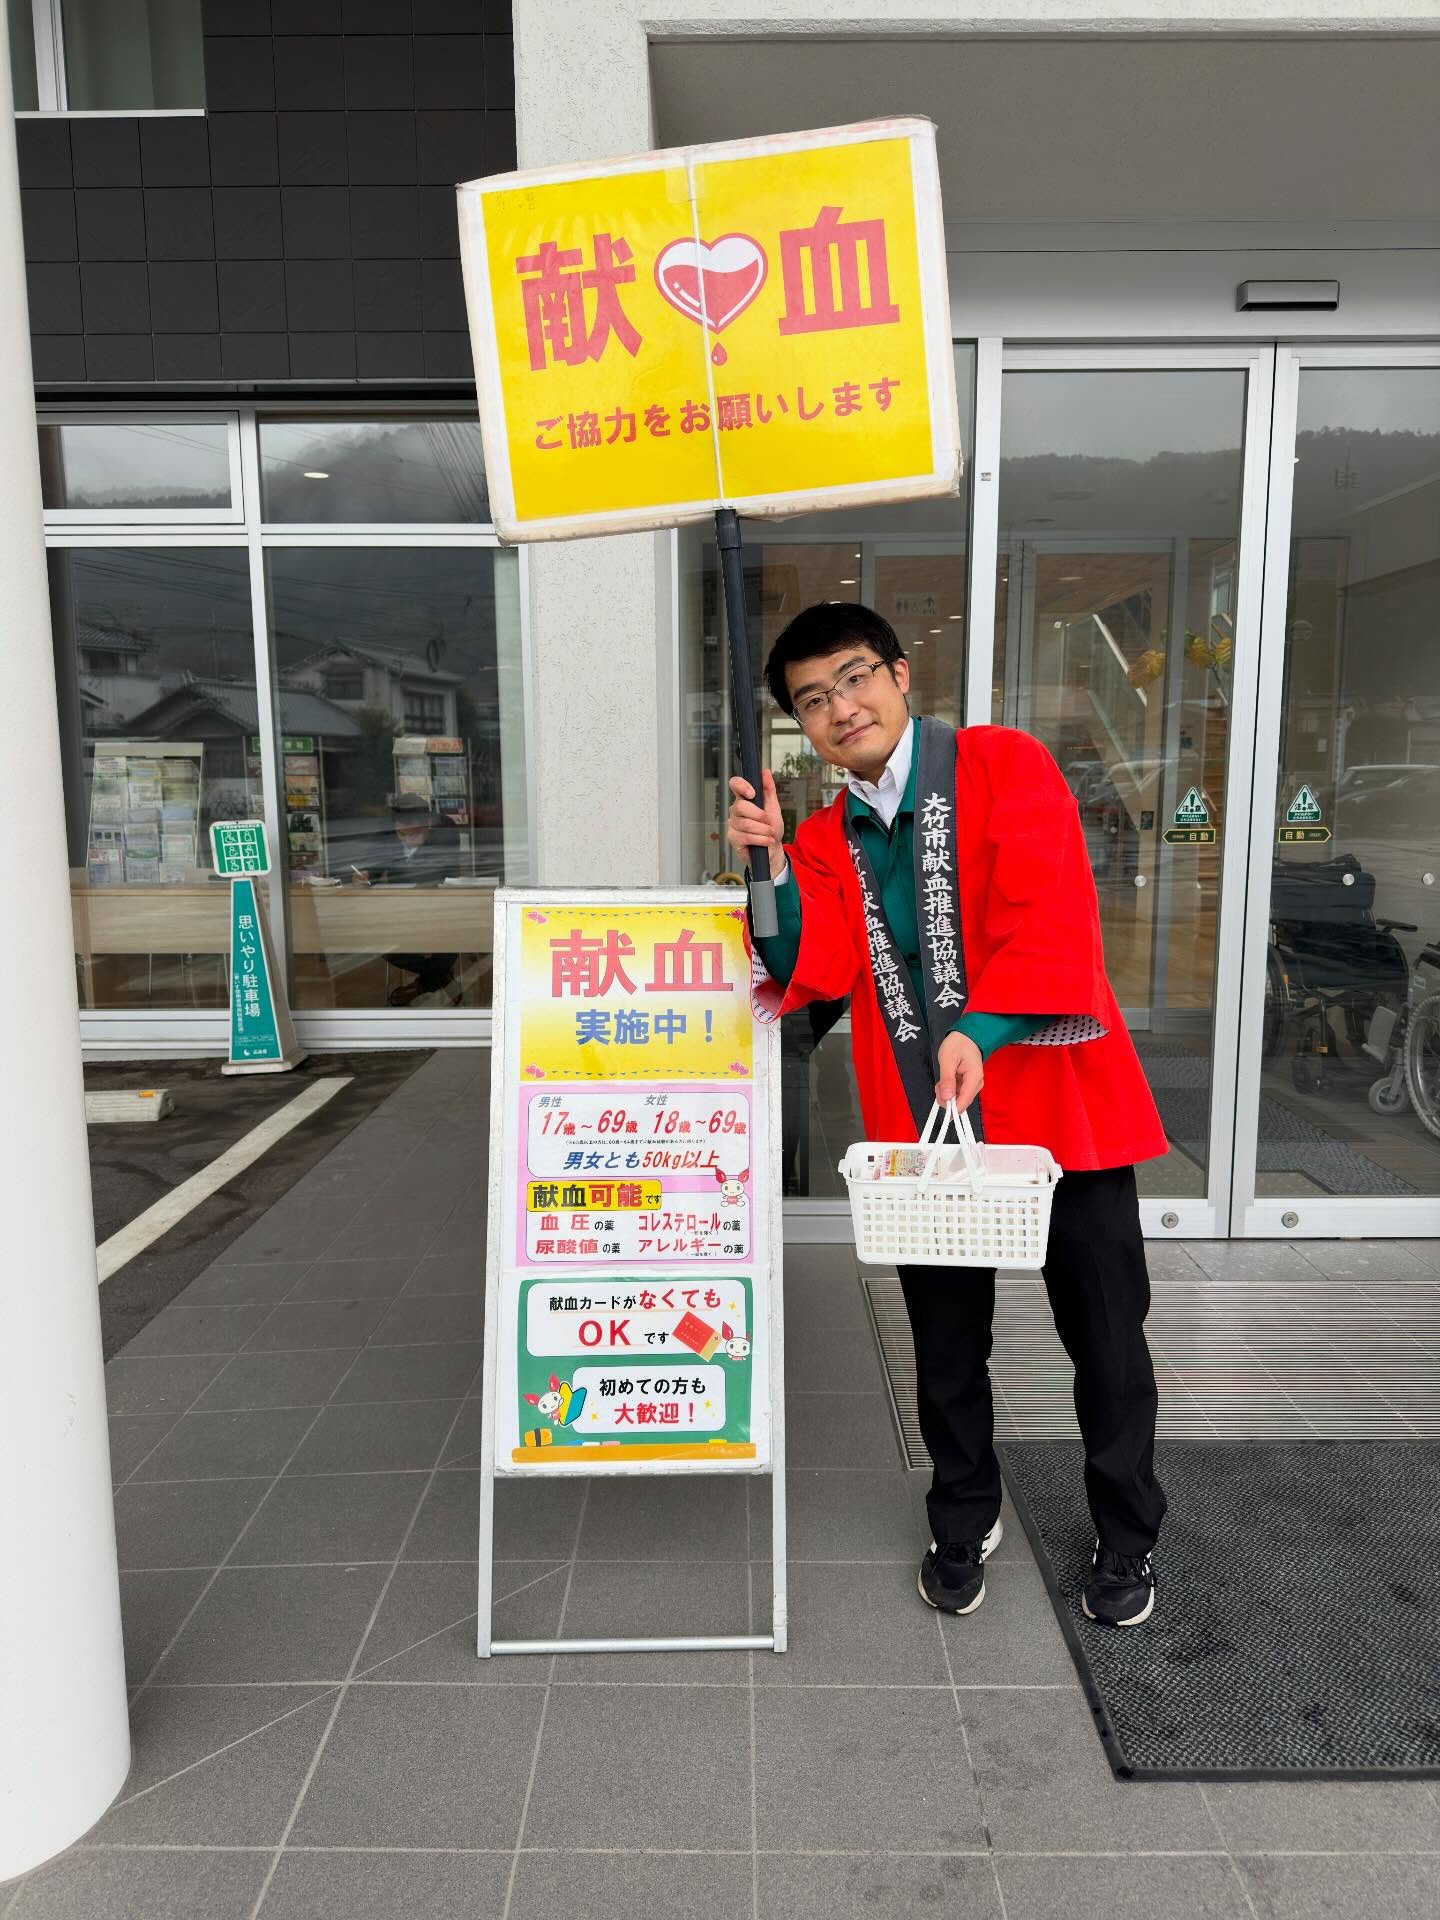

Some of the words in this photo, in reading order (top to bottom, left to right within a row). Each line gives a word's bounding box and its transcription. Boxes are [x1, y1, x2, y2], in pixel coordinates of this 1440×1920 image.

[533, 376, 901, 450] ご協力をお願いします
[920, 792, 967, 1009] 大竹市献血推進協議会
[238, 914, 261, 1018] 思いやり駐車場
[550, 929, 734, 998] 献血
[575, 1009, 713, 1045] 実施中！
[538, 1095, 563, 1108] 男性
[644, 1093, 669, 1106] 女性
[562, 1150, 720, 1170] 男女とも50kg以上
[533, 1183, 662, 1209] 献血可能です
[536, 1239, 621, 1255] 尿酸値の薬
[638, 1238, 744, 1256] アレルギーの薬
[549, 1289, 721, 1312] 献血カードがなくても
[599, 1377, 706, 1396] 初めての方も
[614, 1403, 695, 1425] 大歓迎！
